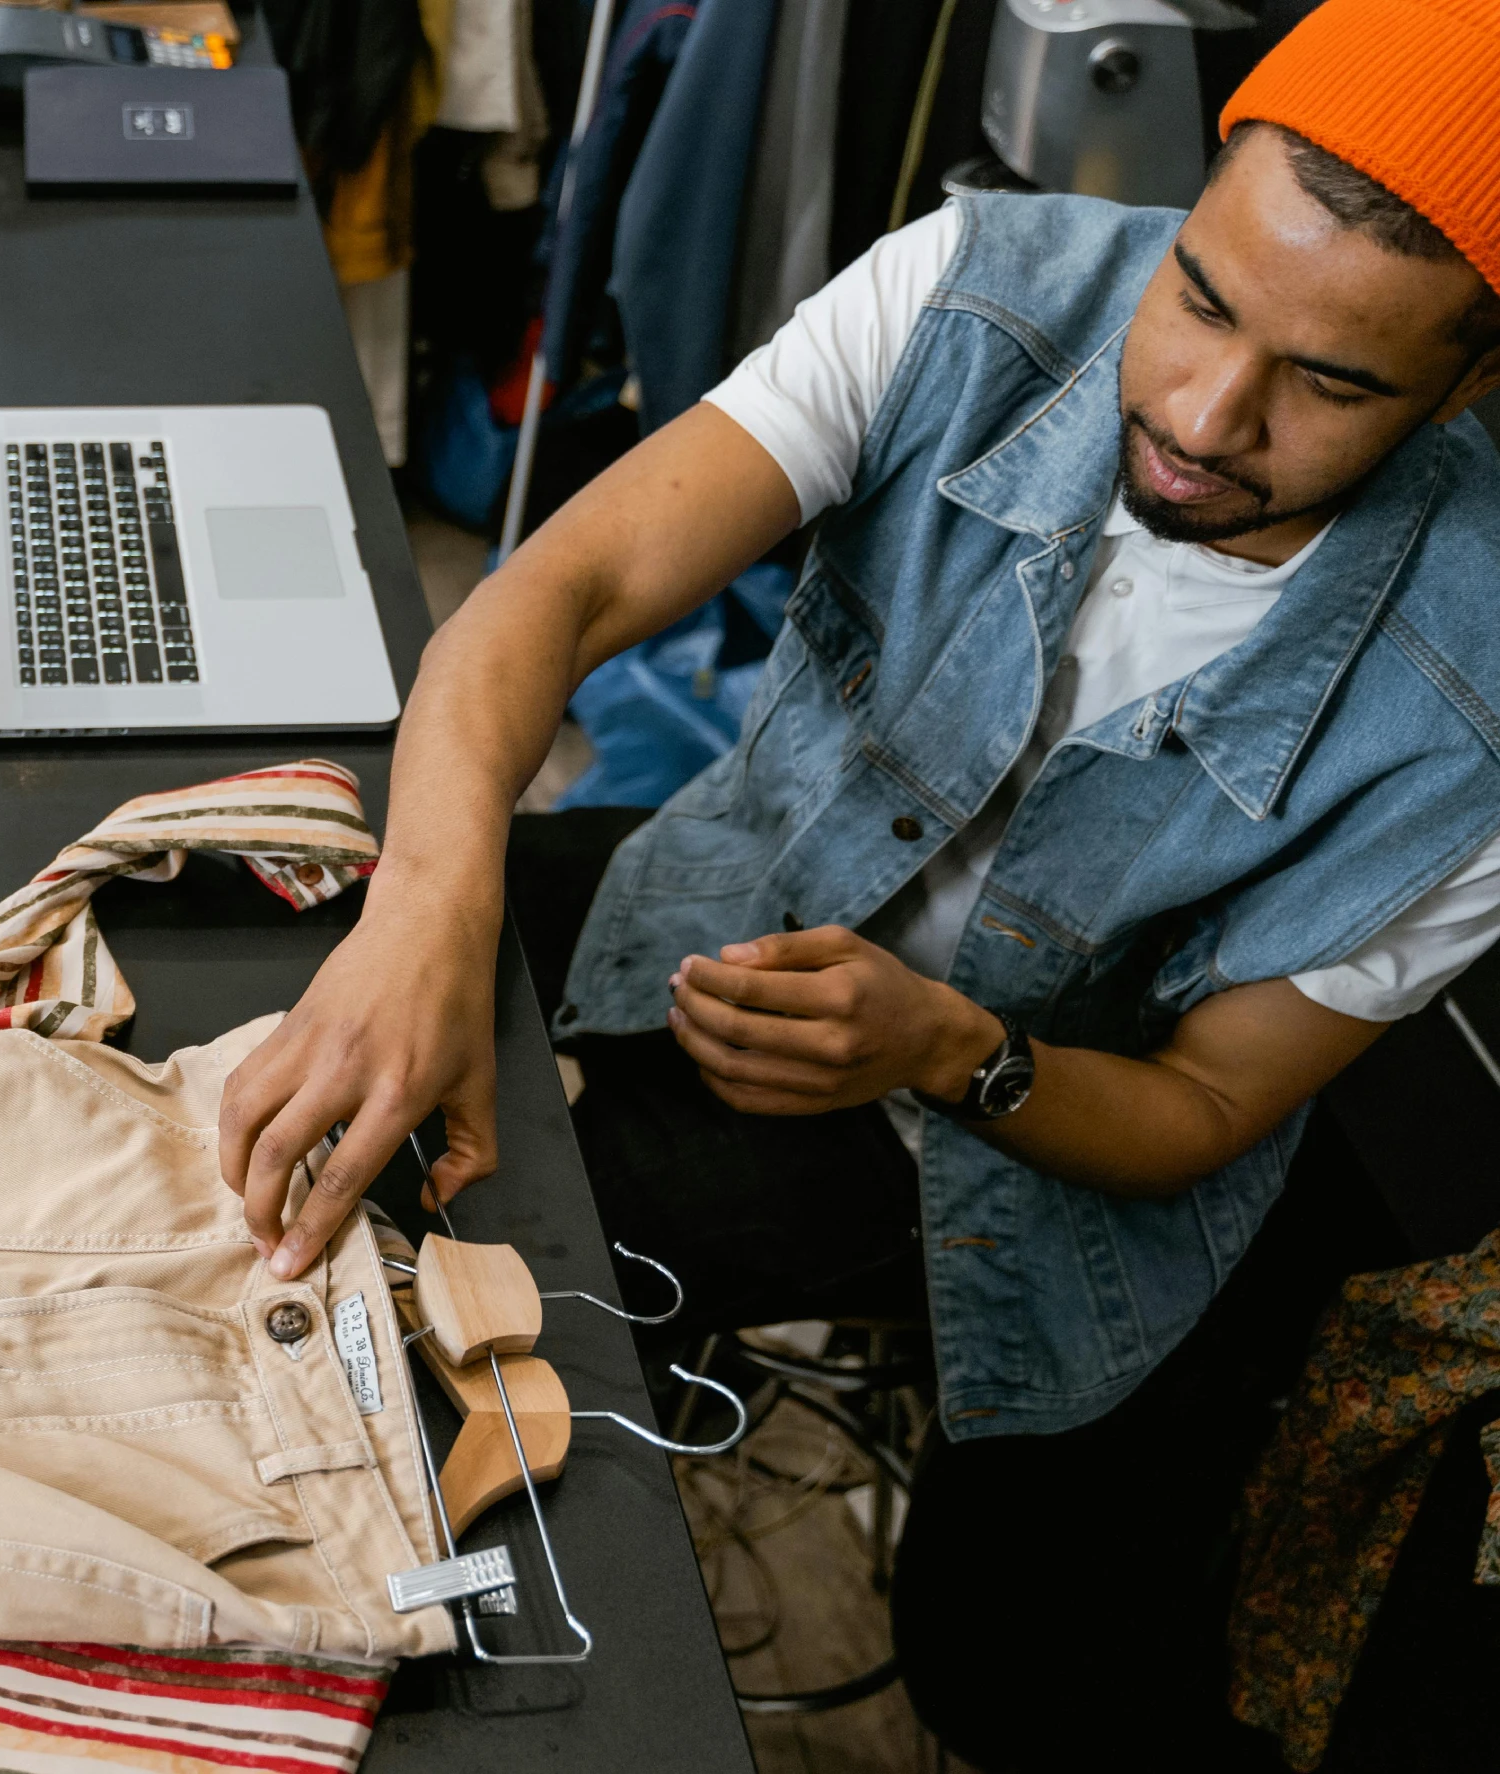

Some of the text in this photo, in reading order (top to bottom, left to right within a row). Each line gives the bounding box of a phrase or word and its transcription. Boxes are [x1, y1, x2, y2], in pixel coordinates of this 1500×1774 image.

[349, 1300, 358, 1308] 6
[352, 1323, 362, 1332] 2
[356, 1337, 367, 1351] 38
